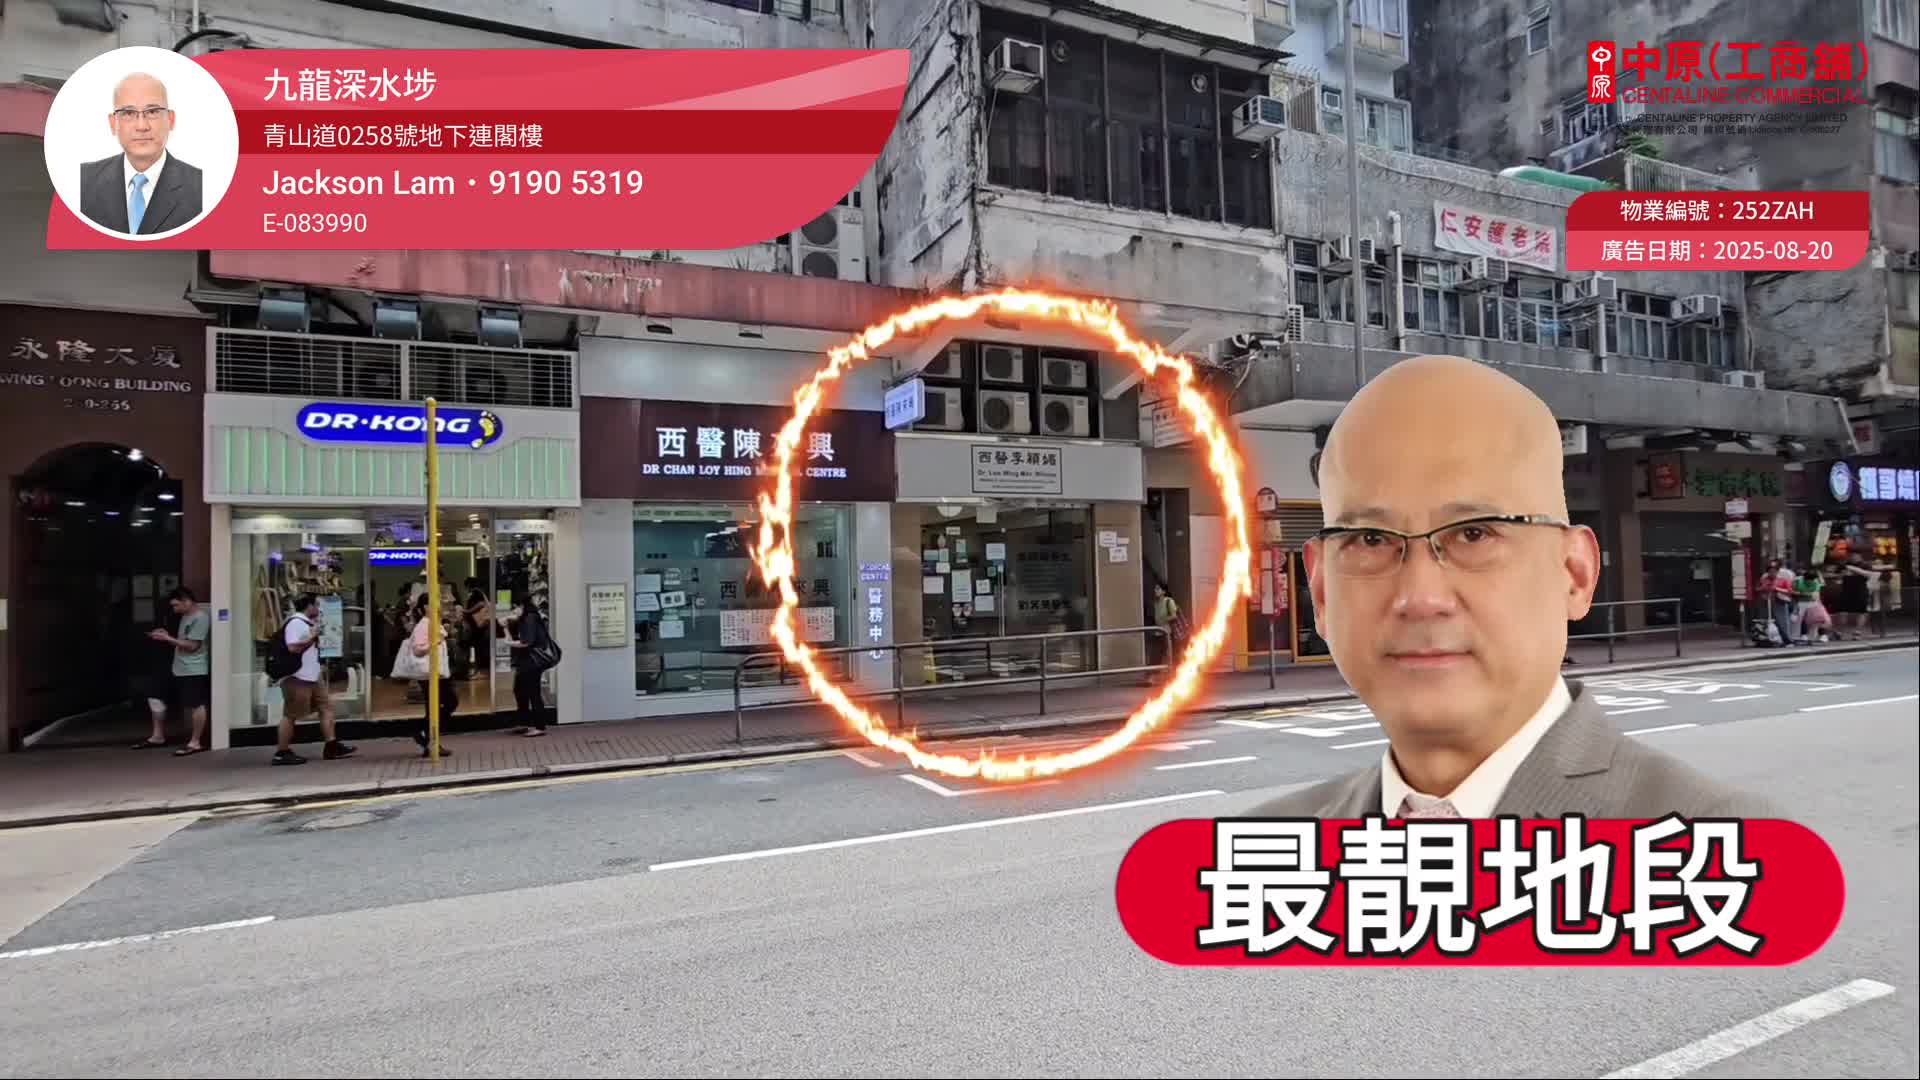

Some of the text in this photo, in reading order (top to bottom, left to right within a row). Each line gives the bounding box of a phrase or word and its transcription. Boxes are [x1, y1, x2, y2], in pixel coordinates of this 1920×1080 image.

[9, 337, 181, 368] 永隆大廈
[50, 376, 110, 389] OONG
[114, 378, 192, 393] BUILDING
[655, 426, 835, 461] 西醫陳興
[642, 463, 661, 475] DR
[663, 464, 695, 476] CHAN
[698, 465, 722, 477] LOY
[724, 466, 752, 477] HING
[805, 467, 848, 478] CENTRE
